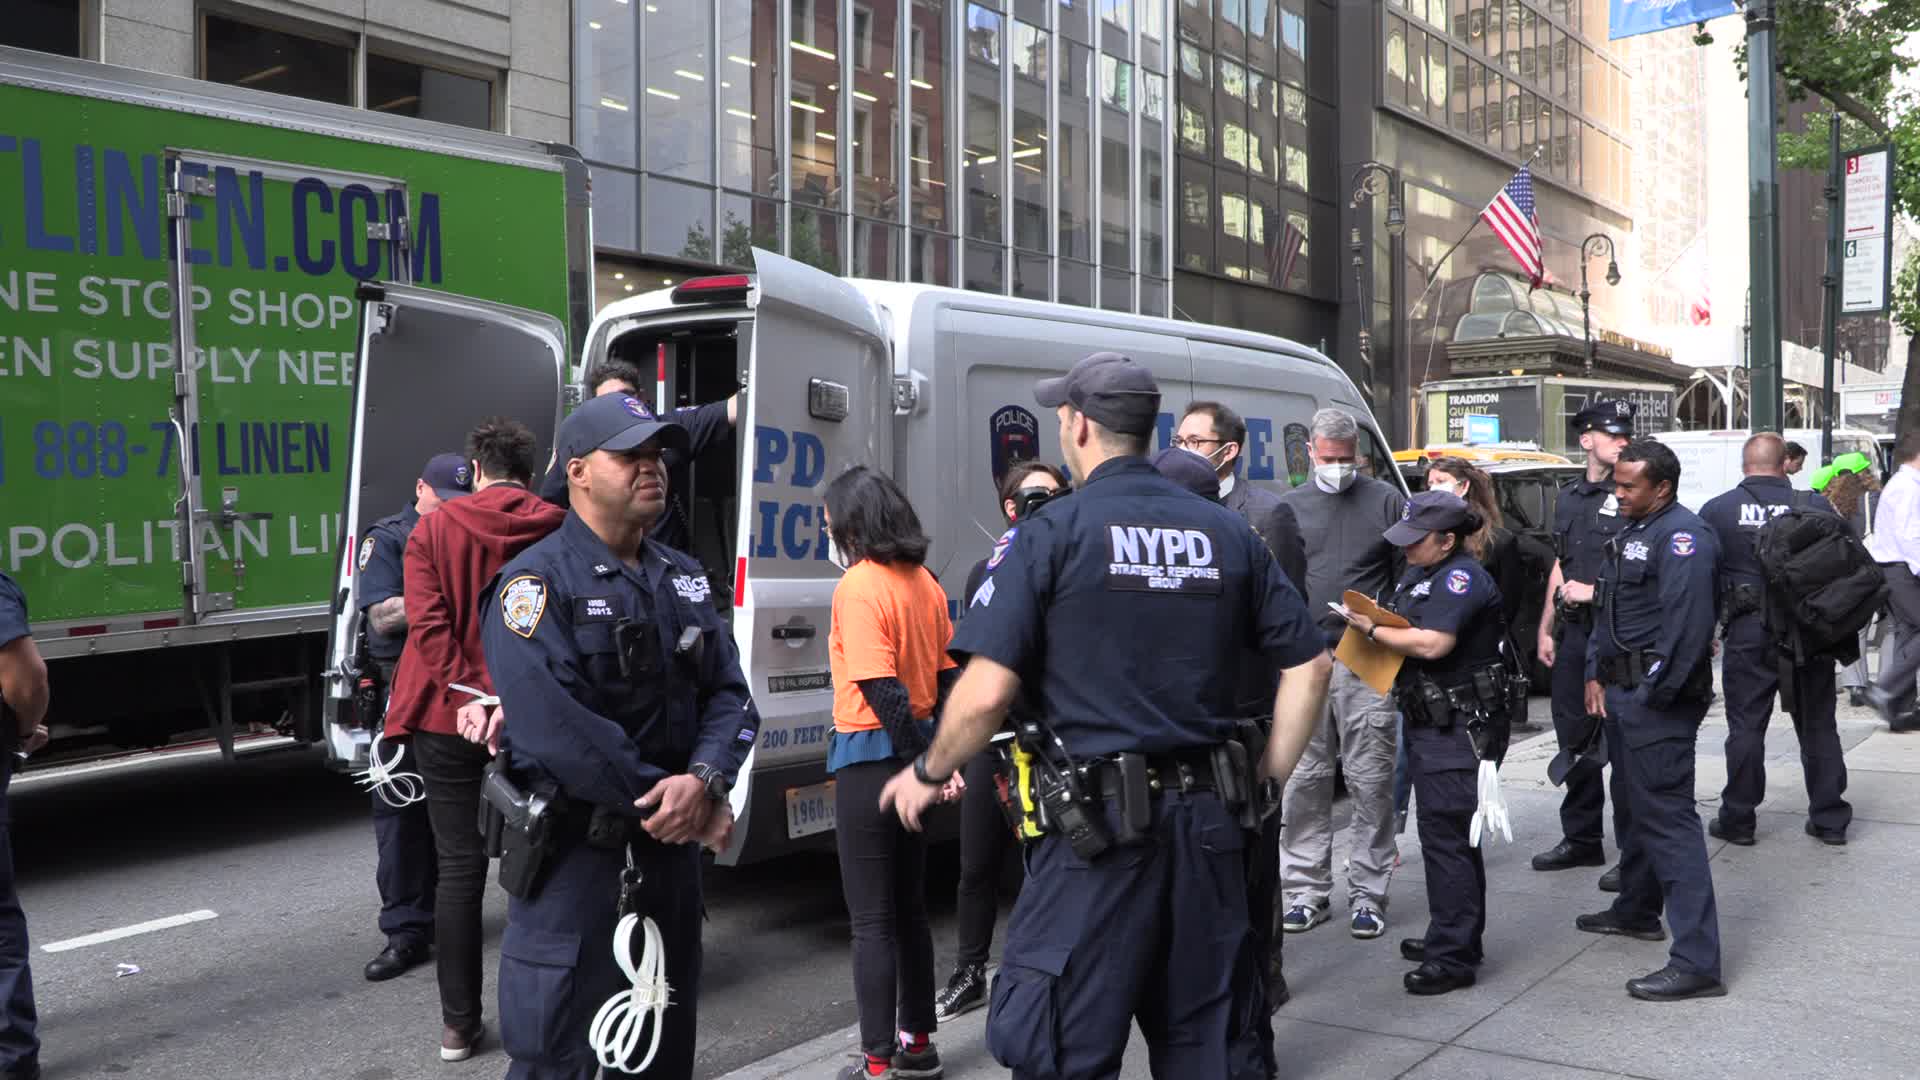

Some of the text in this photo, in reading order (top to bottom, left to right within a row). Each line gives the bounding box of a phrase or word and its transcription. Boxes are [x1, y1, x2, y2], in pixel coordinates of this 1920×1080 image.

[1849, 158, 1857, 173] 3
[0, 135, 441, 284] LINEN.COM
[1847, 242, 1855, 255] 6
[79, 275, 212, 319] STOP
[229, 288, 353, 329] SHOP
[73, 339, 261, 384] SUPPLY
[1449, 393, 1499, 405] TRADITION
[996, 410, 1033, 432] POLICE
[1449, 406, 1488, 417] QUALITY
[216, 422, 330, 475] LINEN
[0, 519, 268, 572] POLITAN
[289, 513, 342, 556] LI
[1110, 525, 1213, 566] NYPD
[1109, 563, 1220, 579] STRATEGIC RESPONSE
[1148, 576, 1183, 589] GROUP
[672, 576, 709, 591] POLICE
[762, 725, 825, 749] 200 FEET
[793, 797, 824, 825] 1960
